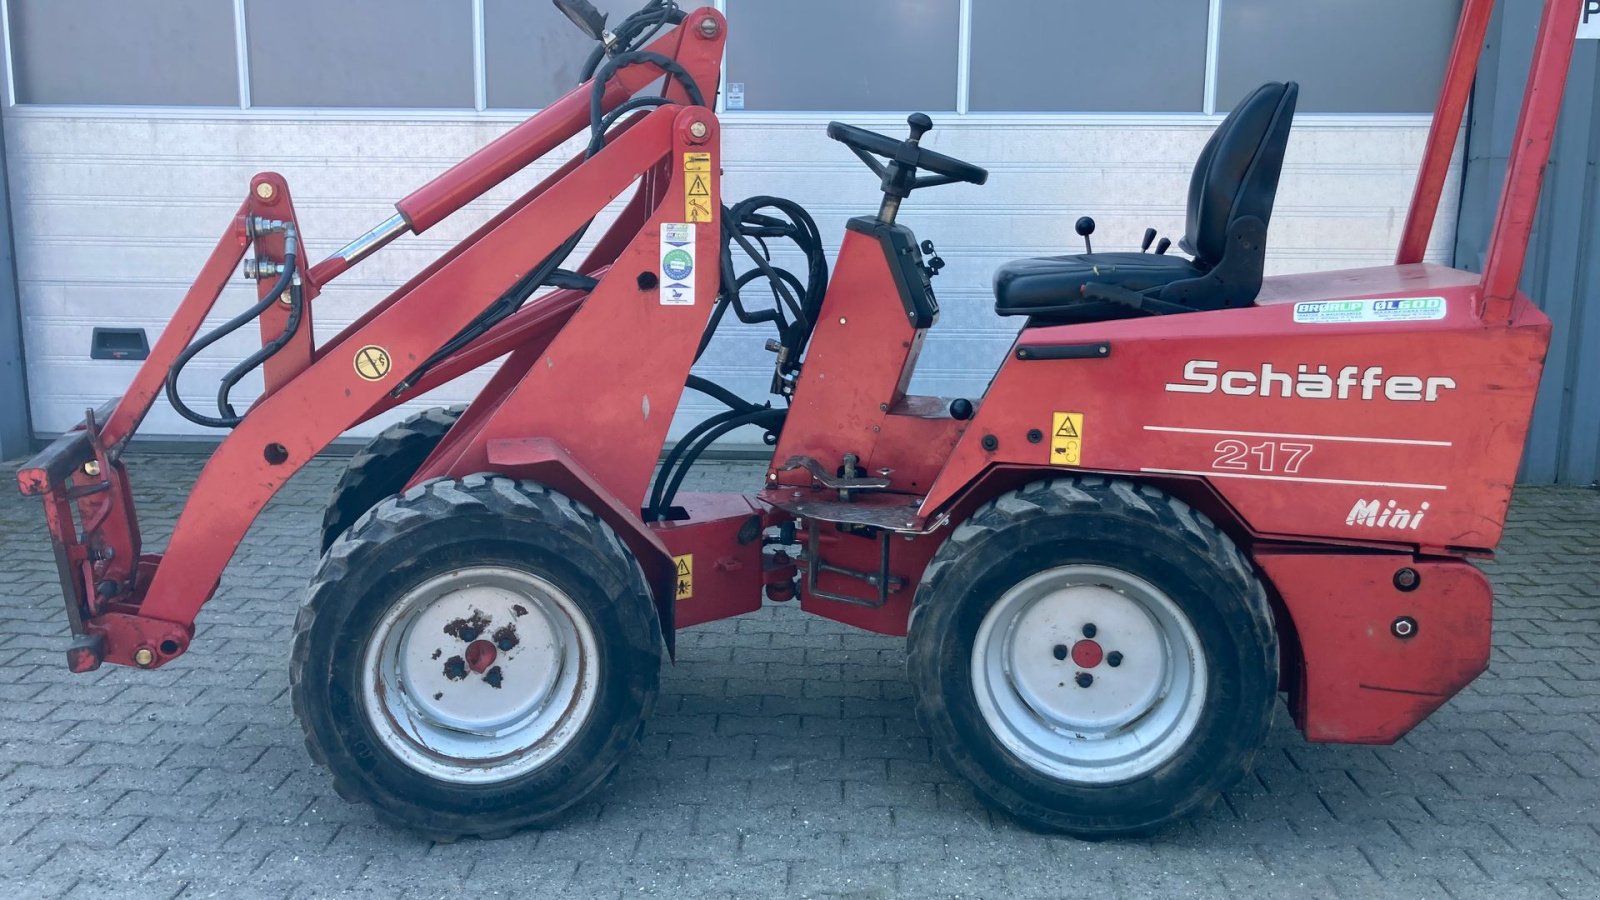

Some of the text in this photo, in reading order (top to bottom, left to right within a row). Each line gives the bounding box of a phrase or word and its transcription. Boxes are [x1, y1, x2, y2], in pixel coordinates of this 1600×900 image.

[1165, 359, 1456, 401] Schäffer
[1212, 439, 1313, 473] 217
[1345, 498, 1430, 530] Mini
